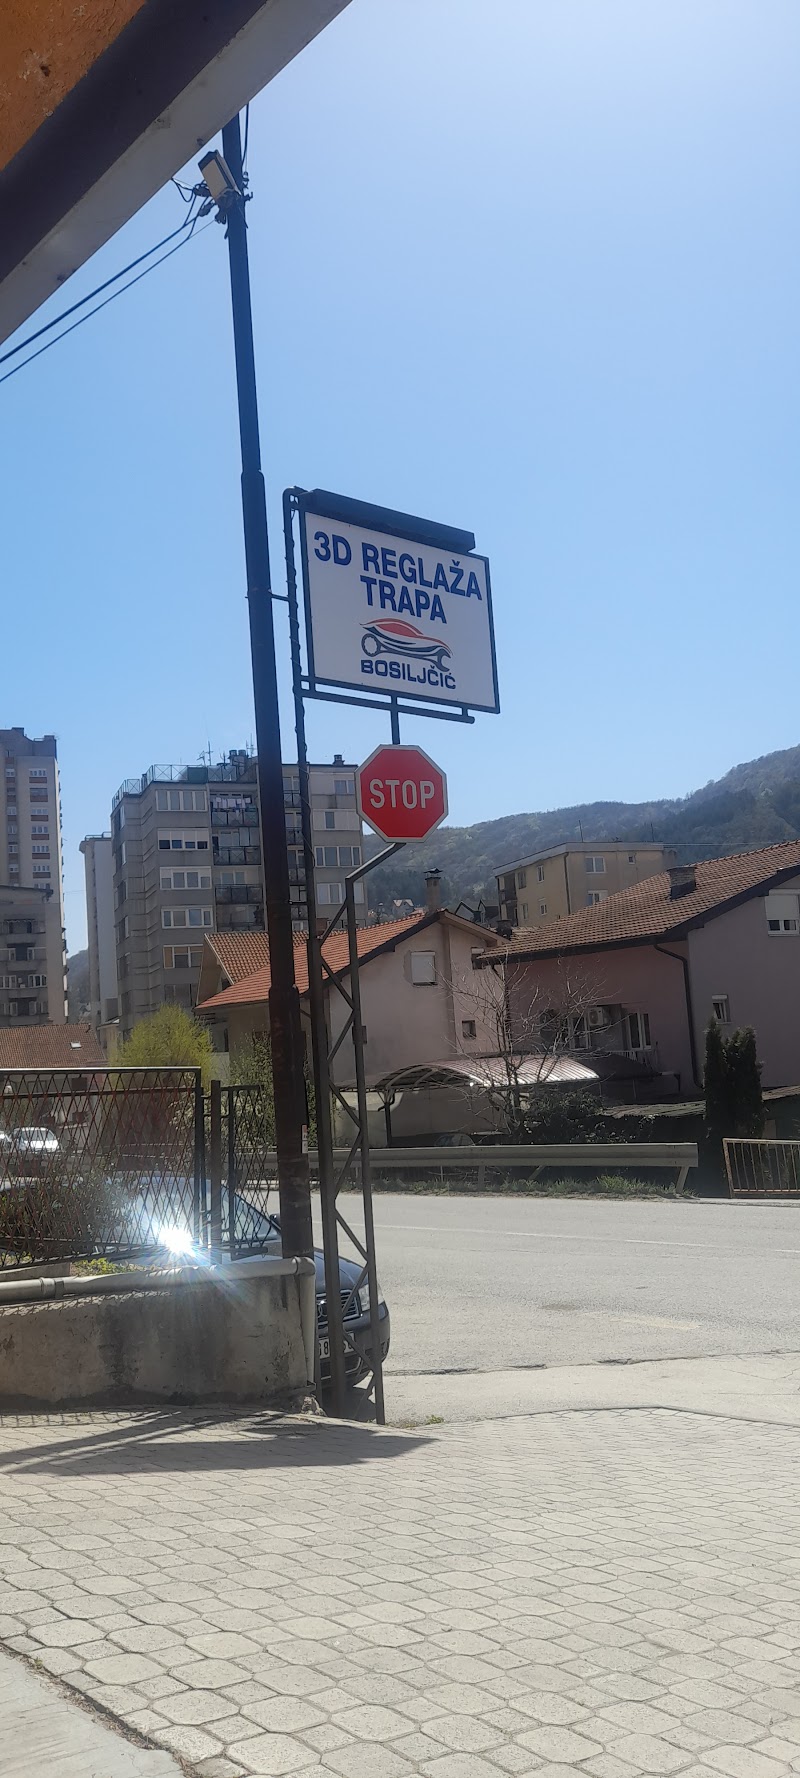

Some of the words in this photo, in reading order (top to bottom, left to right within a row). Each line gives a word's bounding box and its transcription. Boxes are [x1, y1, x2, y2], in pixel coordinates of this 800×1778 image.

[314, 531, 352, 566] 3D
[361, 542, 482, 600] REGLAŽA
[360, 575, 447, 623] TRAPA
[361, 659, 456, 689] BOSILJČIĆ
[370, 779, 435, 809] STOP
